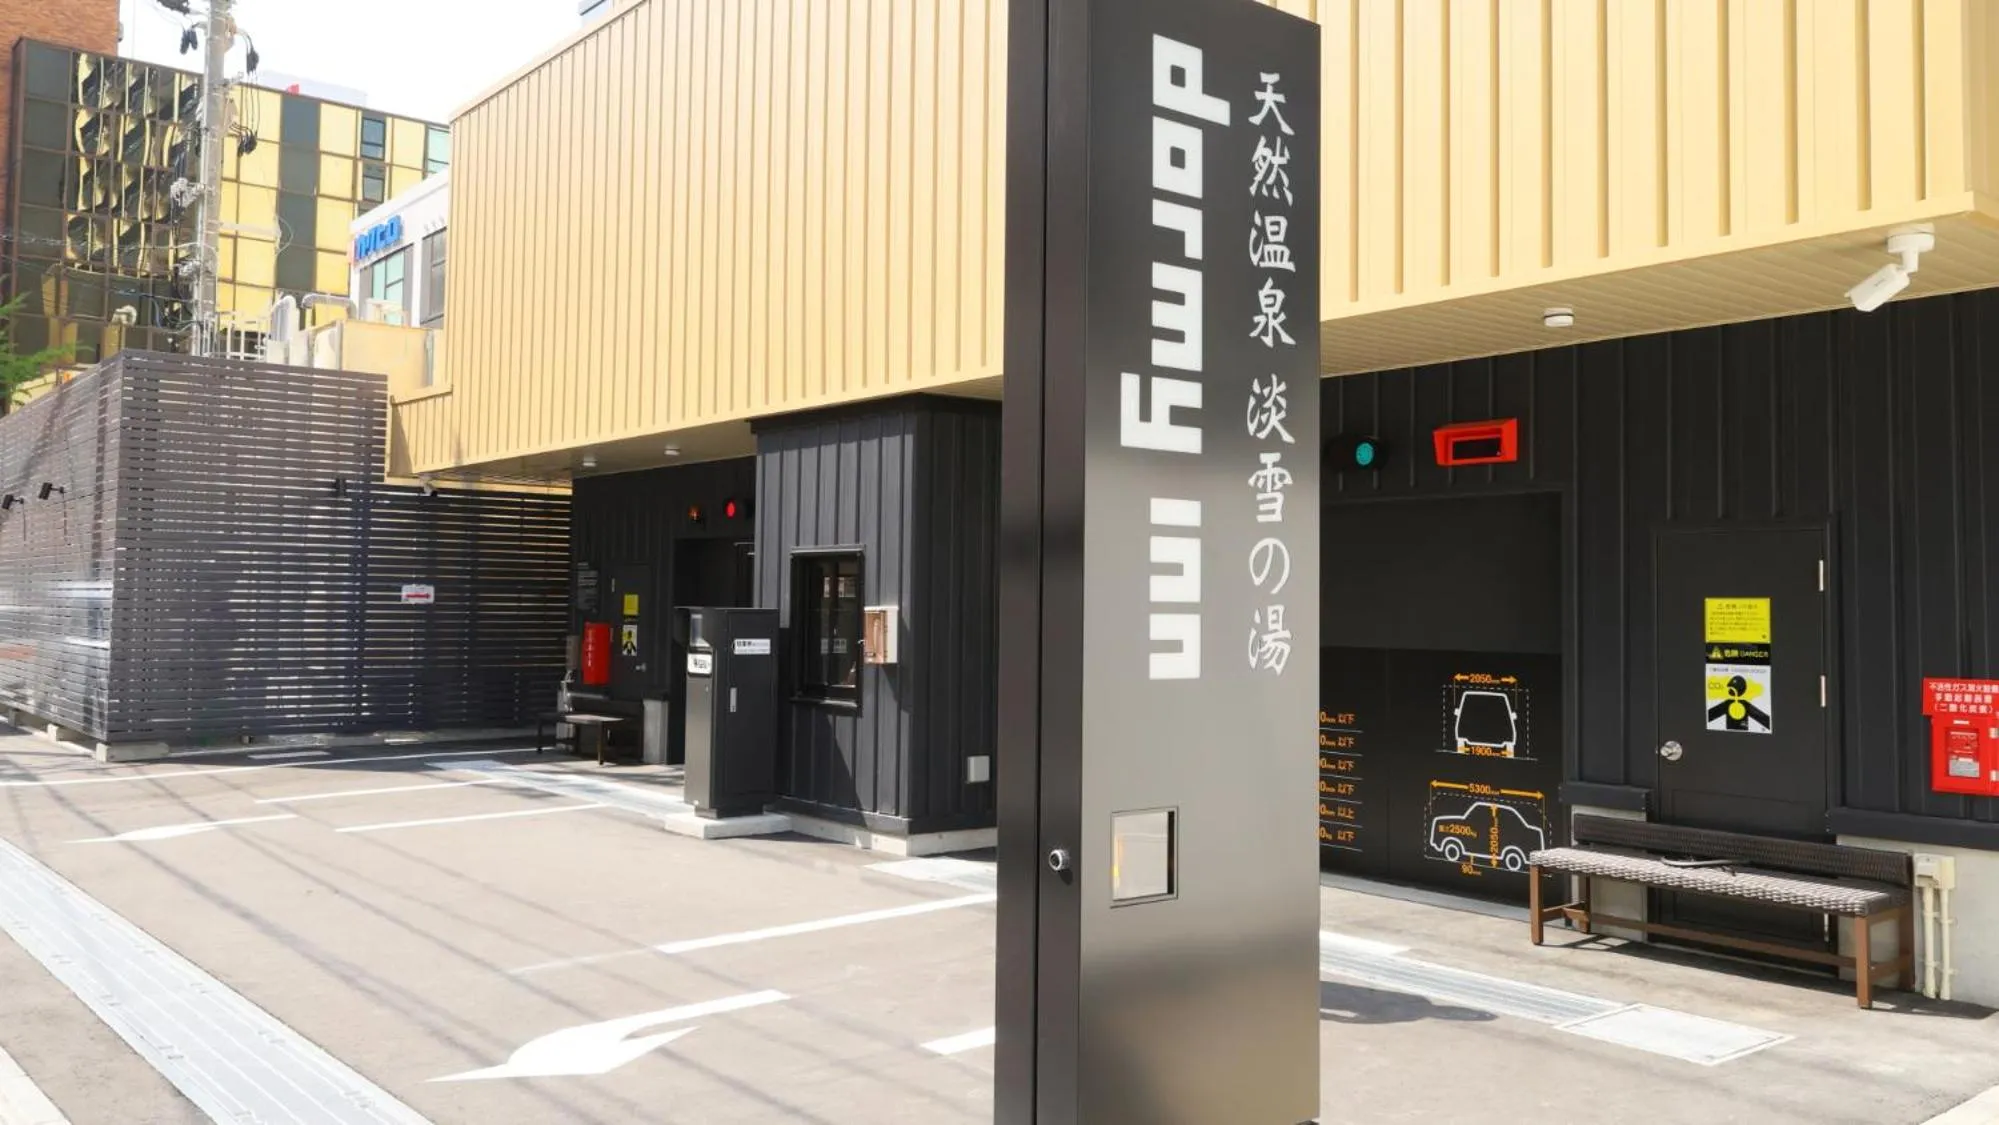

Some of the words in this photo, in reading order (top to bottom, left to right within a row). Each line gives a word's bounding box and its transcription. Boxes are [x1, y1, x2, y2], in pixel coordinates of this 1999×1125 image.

[1121, 34, 1230, 454] dormy
[1248, 72, 1296, 348] 天然温泉
[1150, 498, 1202, 679] inn
[1247, 374, 1295, 676] 淡雪の湯
